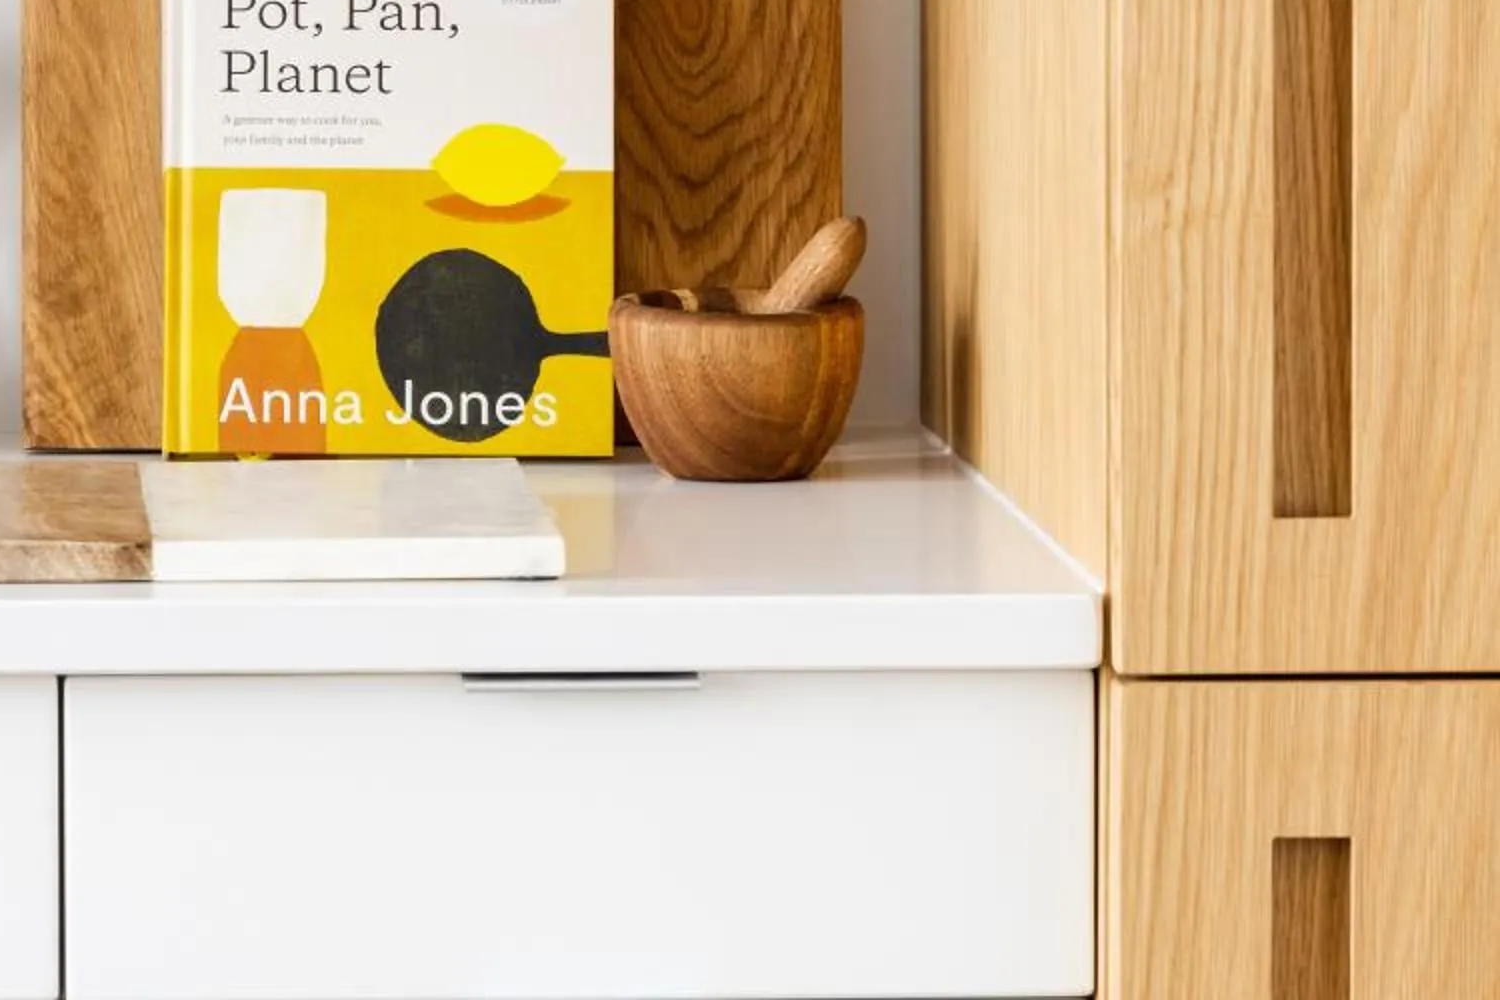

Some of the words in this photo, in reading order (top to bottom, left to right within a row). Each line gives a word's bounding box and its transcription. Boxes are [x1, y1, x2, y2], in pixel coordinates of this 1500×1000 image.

[220, 49, 393, 95] Planet
[218, 377, 364, 425] Anna
[385, 379, 558, 427] Jones
